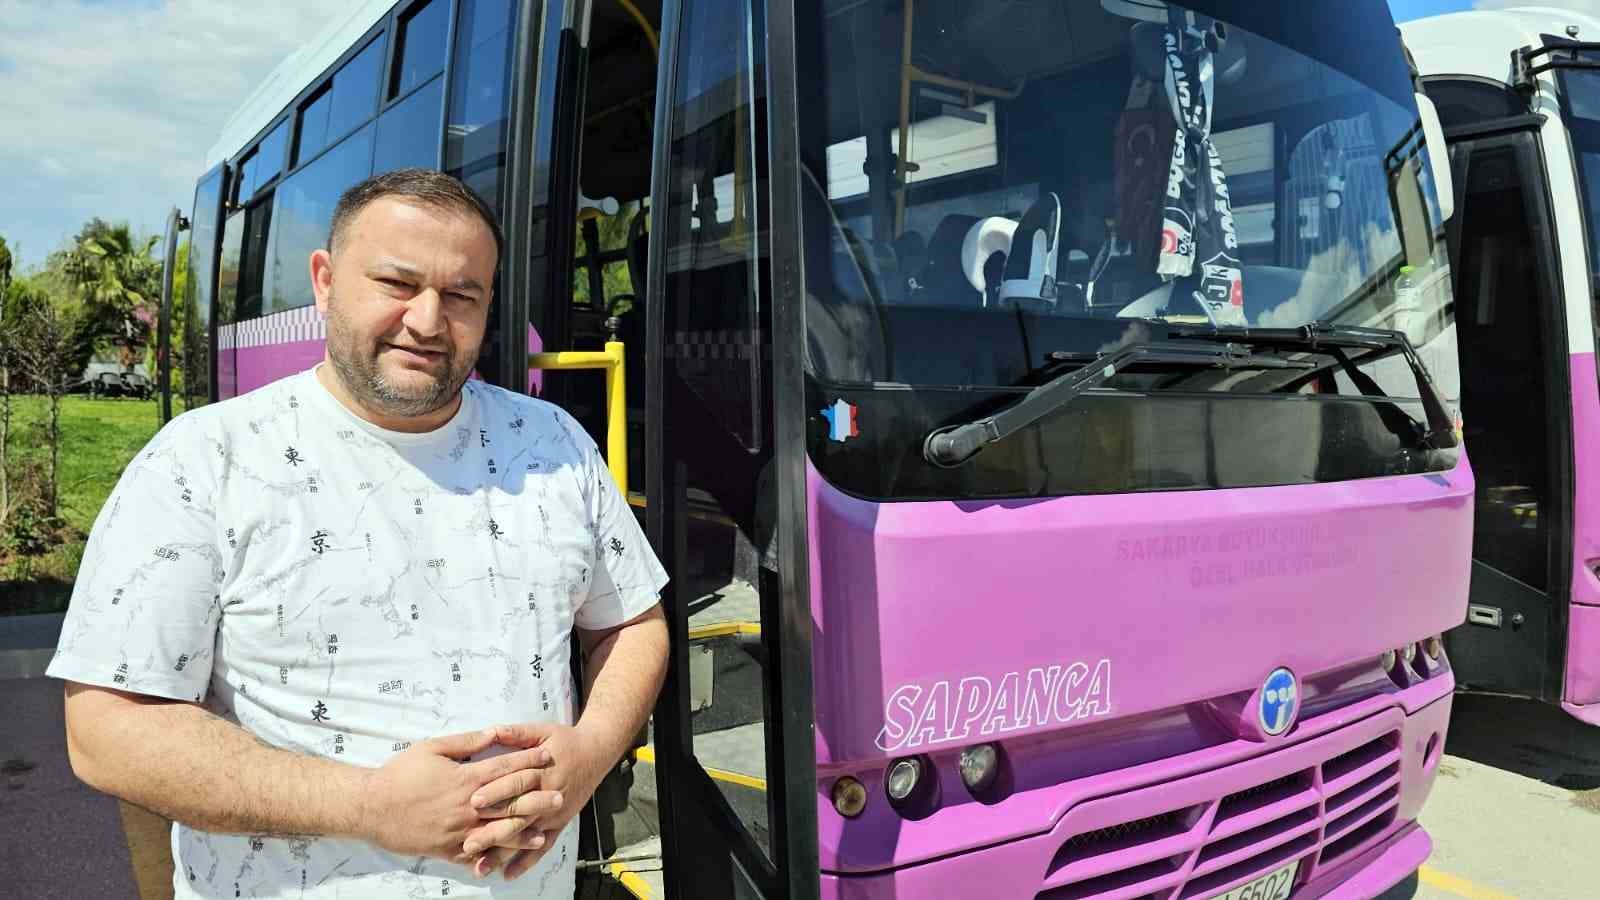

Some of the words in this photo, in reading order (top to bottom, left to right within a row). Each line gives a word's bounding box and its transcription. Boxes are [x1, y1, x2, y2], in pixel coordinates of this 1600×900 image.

[284, 446, 305, 467] 東
[310, 530, 331, 555] 京
[310, 700, 331, 724] 東
[874, 659, 1112, 752] SAPANCA
